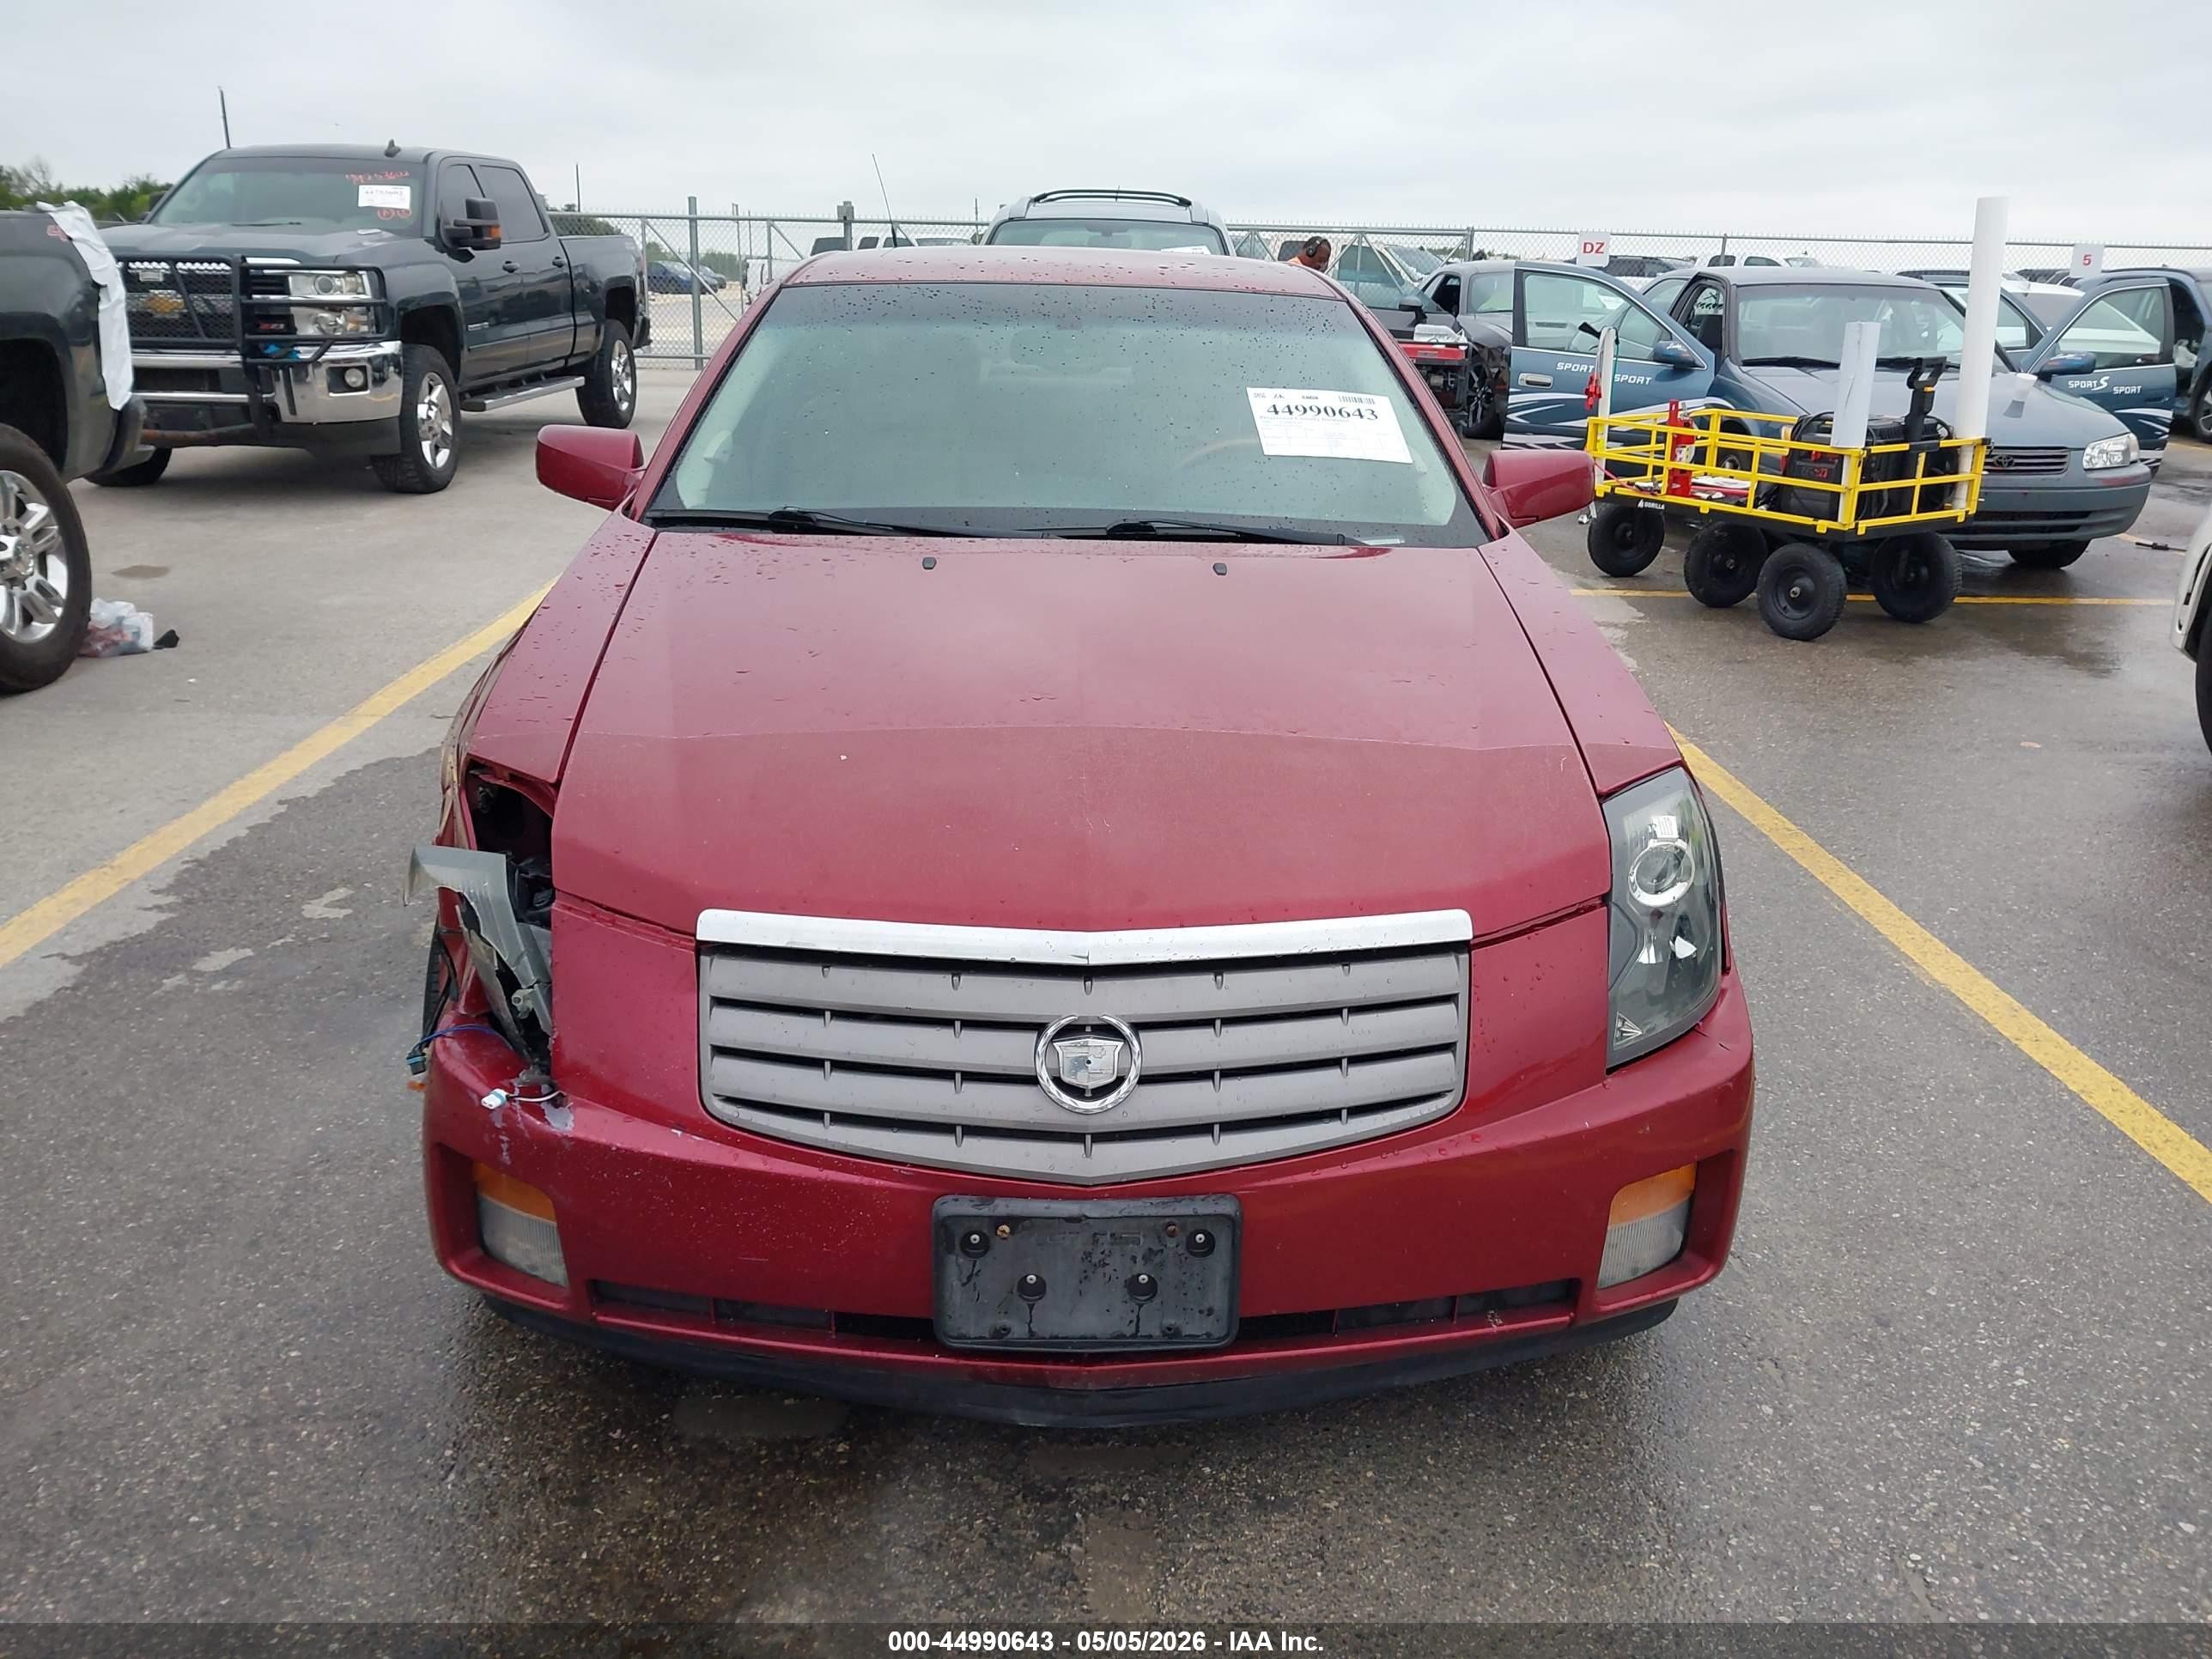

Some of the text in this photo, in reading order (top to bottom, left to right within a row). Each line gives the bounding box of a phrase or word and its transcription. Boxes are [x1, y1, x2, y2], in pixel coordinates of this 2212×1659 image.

[1583, 242, 1605, 254] DZ
[2082, 254, 2092, 266] 5
[1556, 362, 1651, 386] SPORT SPORT
[2068, 380, 2098, 389] SPORT
[2112, 386, 2142, 394] SPORT
[1267, 404, 1378, 421] 44990643
[1644, 501, 1664, 510] GORILLA
